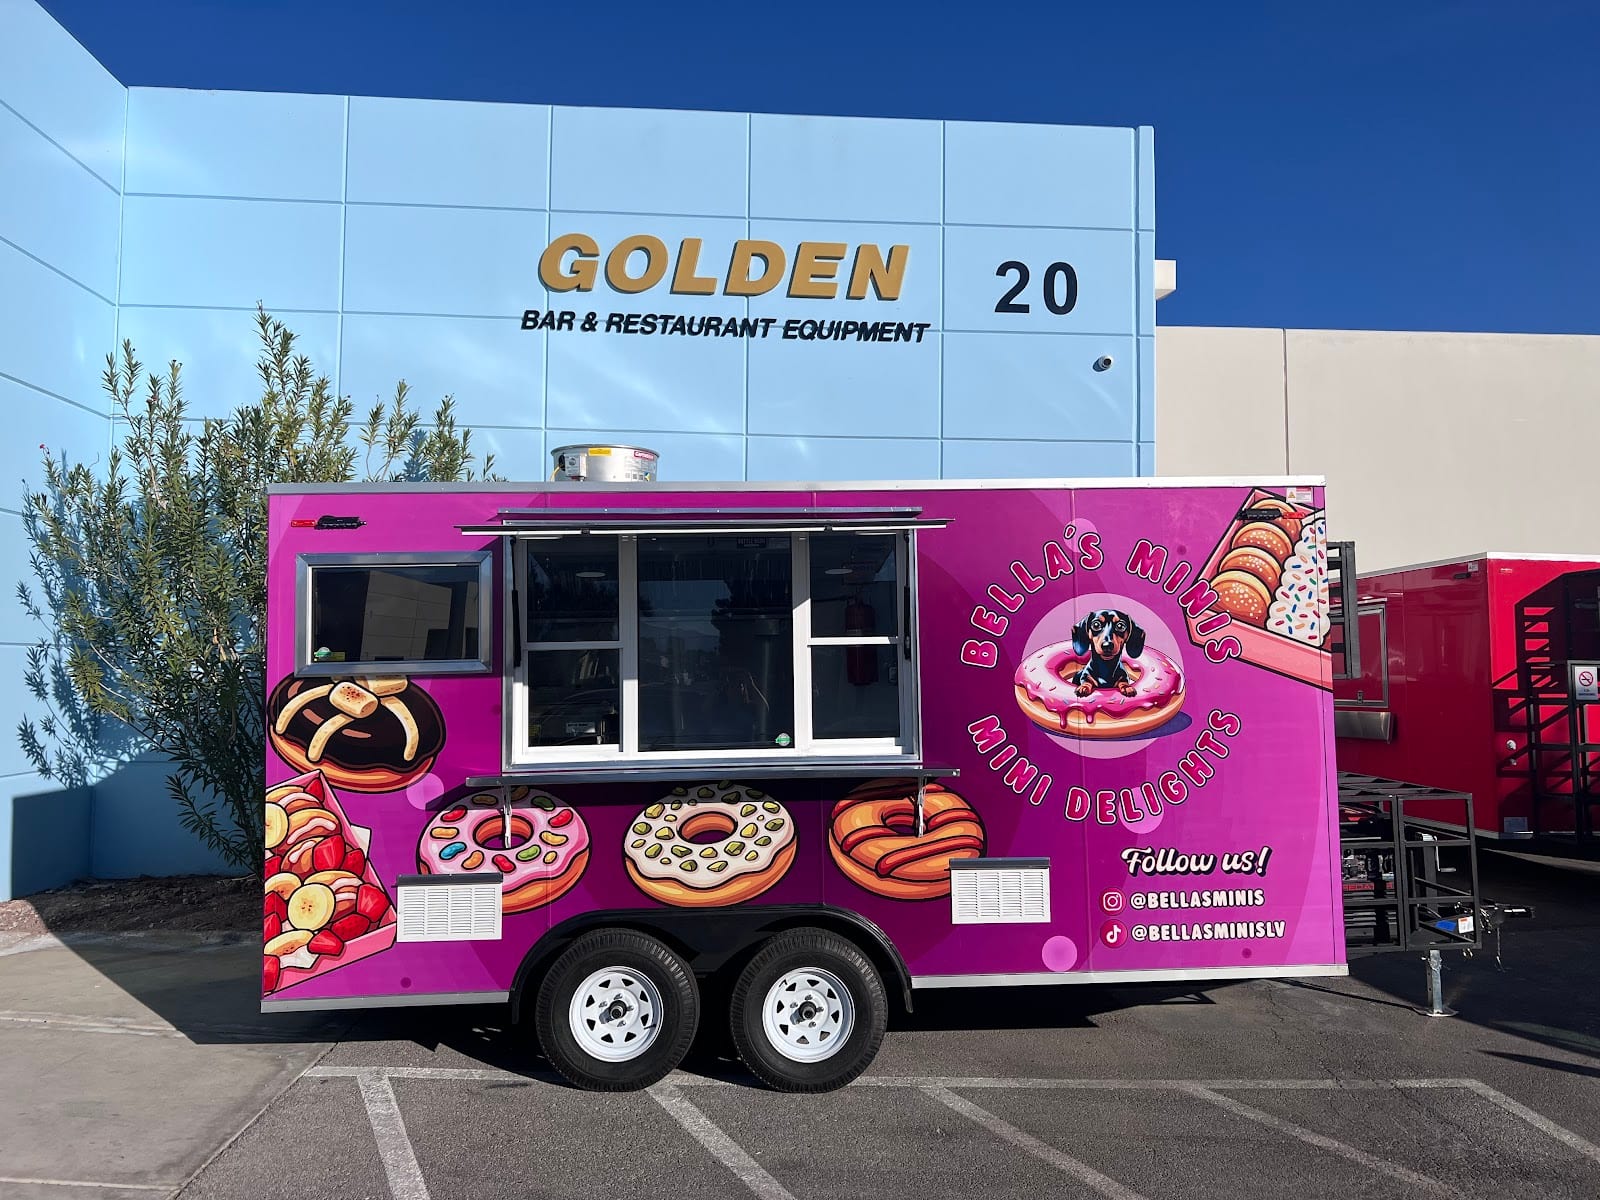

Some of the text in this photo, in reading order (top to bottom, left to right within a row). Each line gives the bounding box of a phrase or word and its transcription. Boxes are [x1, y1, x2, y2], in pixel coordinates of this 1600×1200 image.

[538, 233, 910, 301] GOLDEN
[994, 260, 1078, 316] 20
[521, 310, 931, 343] BAR & RESTAURANT EQUIPMENT
[961, 525, 1241, 668] BELLA'S MINIS
[968, 709, 1241, 825] MINI DELIGHTS
[1121, 846, 1272, 877] Follow us!
[1130, 889, 1265, 910] @BELLASMINIS
[1131, 920, 1287, 942] @BELLASMINISLV
